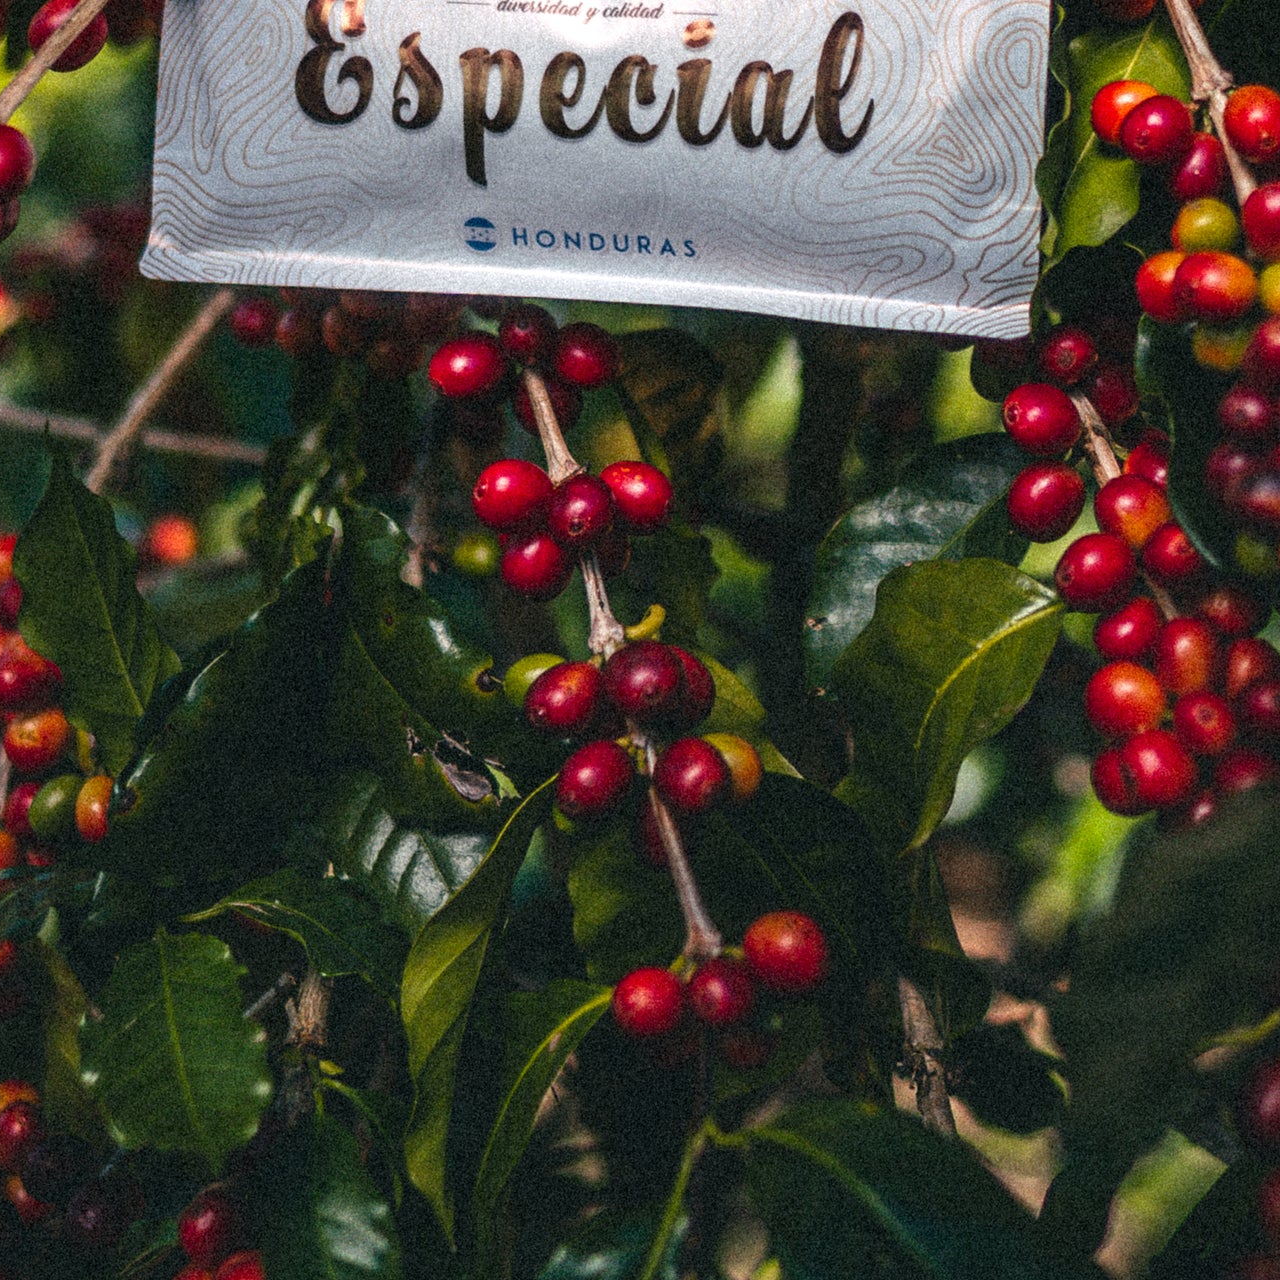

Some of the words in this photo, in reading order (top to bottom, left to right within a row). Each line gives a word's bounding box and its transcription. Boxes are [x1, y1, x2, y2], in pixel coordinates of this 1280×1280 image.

[585, 6, 600, 25] y
[602, 1, 665, 19] calidad
[512, 227, 697, 258] HONDURAS
